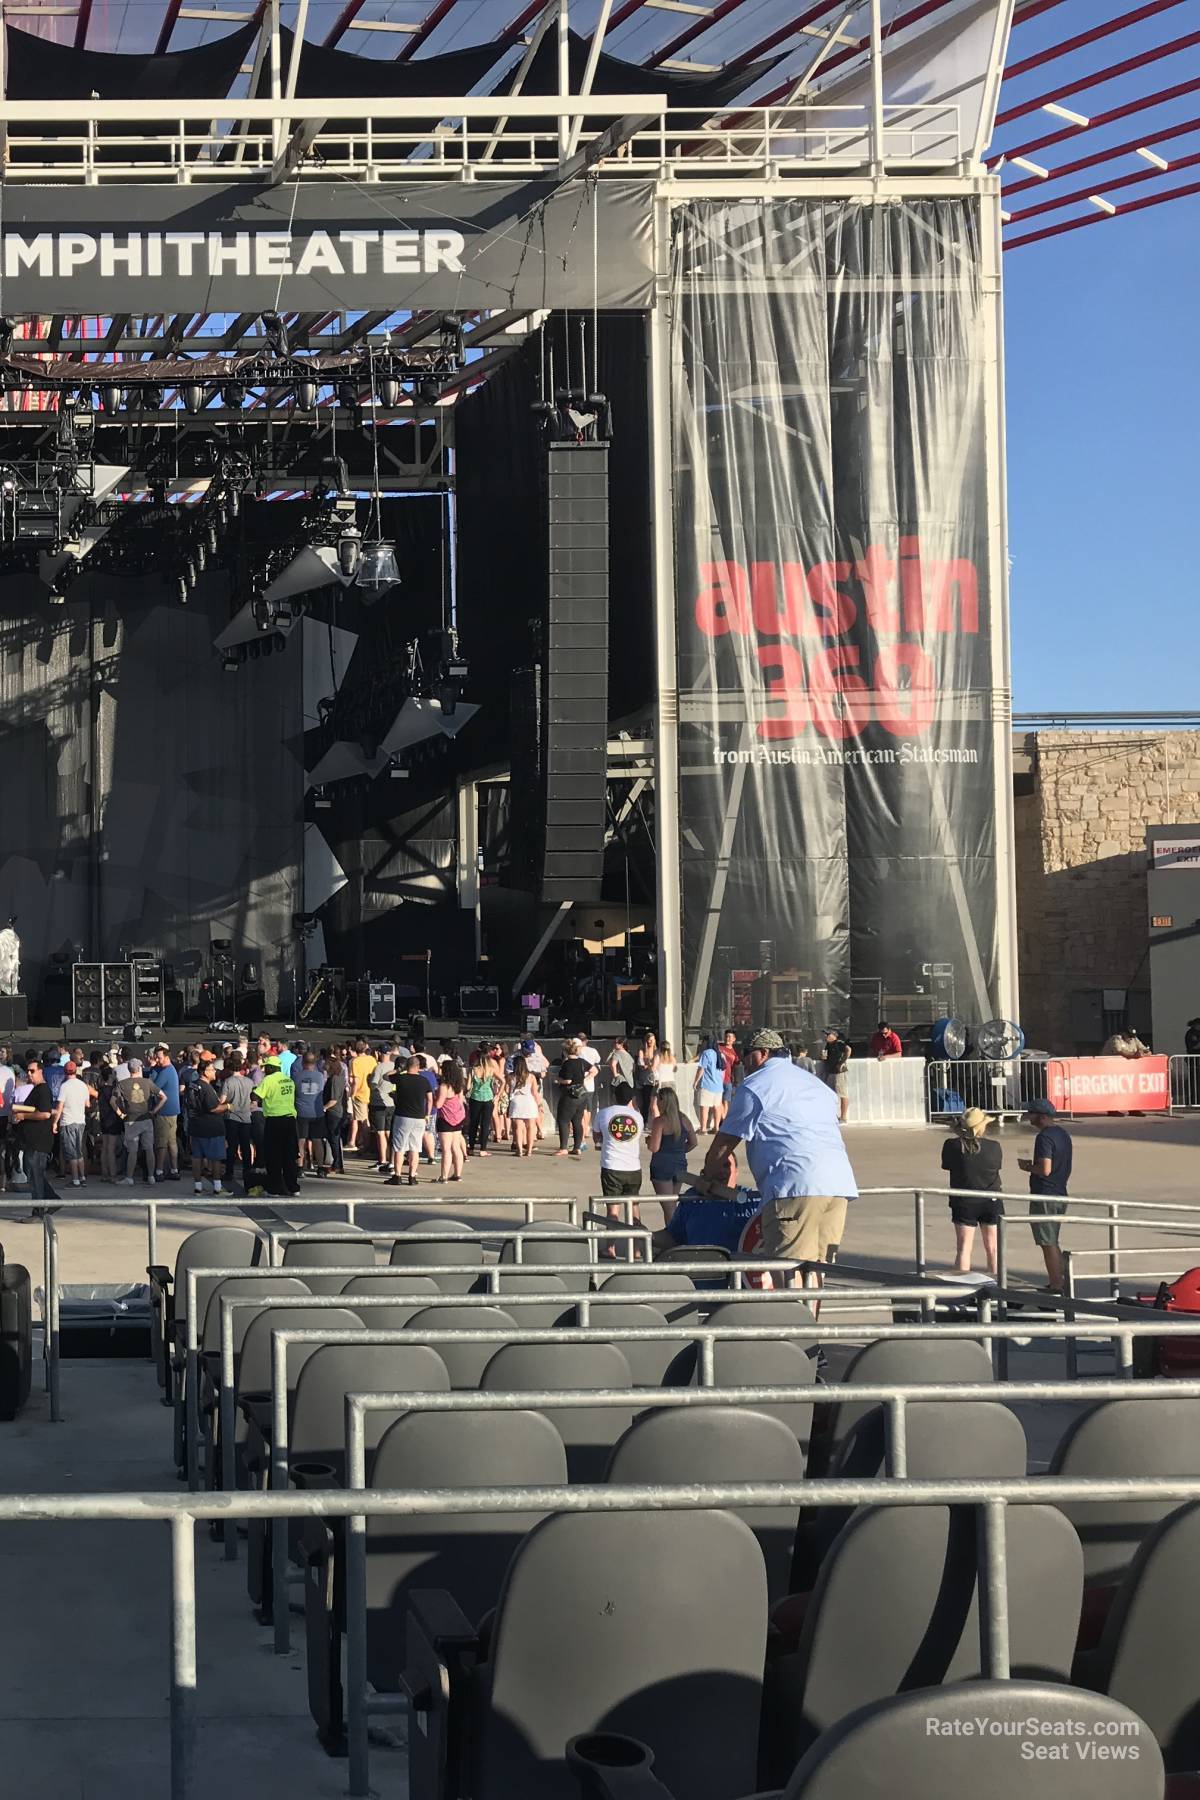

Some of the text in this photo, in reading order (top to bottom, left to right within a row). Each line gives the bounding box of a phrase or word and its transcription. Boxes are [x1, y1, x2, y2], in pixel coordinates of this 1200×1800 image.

[695, 534, 979, 637] austin
[756, 642, 935, 739] 360
[713, 747, 756, 765] from
[757, 745, 813, 766] Austin
[1139, 1072, 1166, 1093] EXIT
[611, 1123, 637, 1133] DEAD
